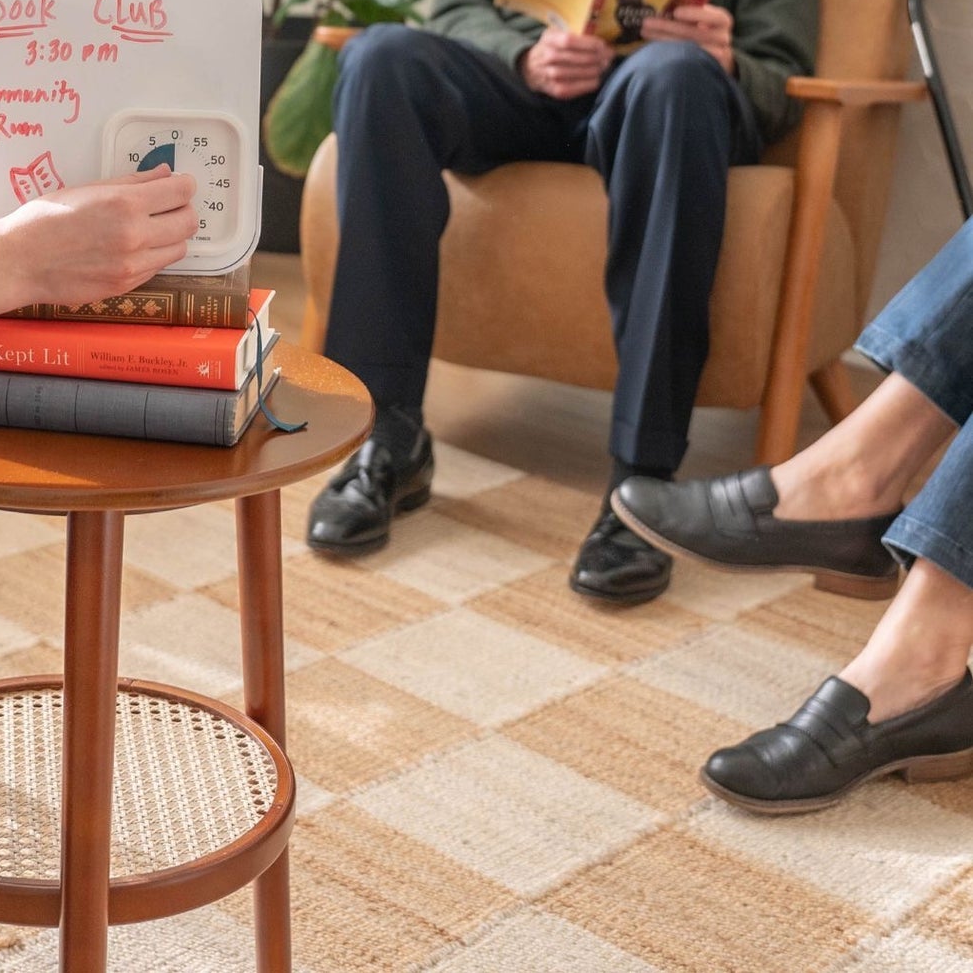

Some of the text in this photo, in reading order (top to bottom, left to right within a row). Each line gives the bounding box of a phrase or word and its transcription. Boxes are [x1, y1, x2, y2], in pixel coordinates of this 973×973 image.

[25, 39, 72, 66] 3:30
[171, 130, 179, 140] 0
[149, 136, 156, 146] 5
[193, 137, 208, 147] 55
[128, 153, 140, 163] 10
[210, 155, 226, 165] 50
[215, 179, 230, 189] 45
[208, 201, 224, 212] 40
[198, 219, 207, 229] 5
[44, 348, 70, 366] Lit
[90, 351, 125, 363] William
